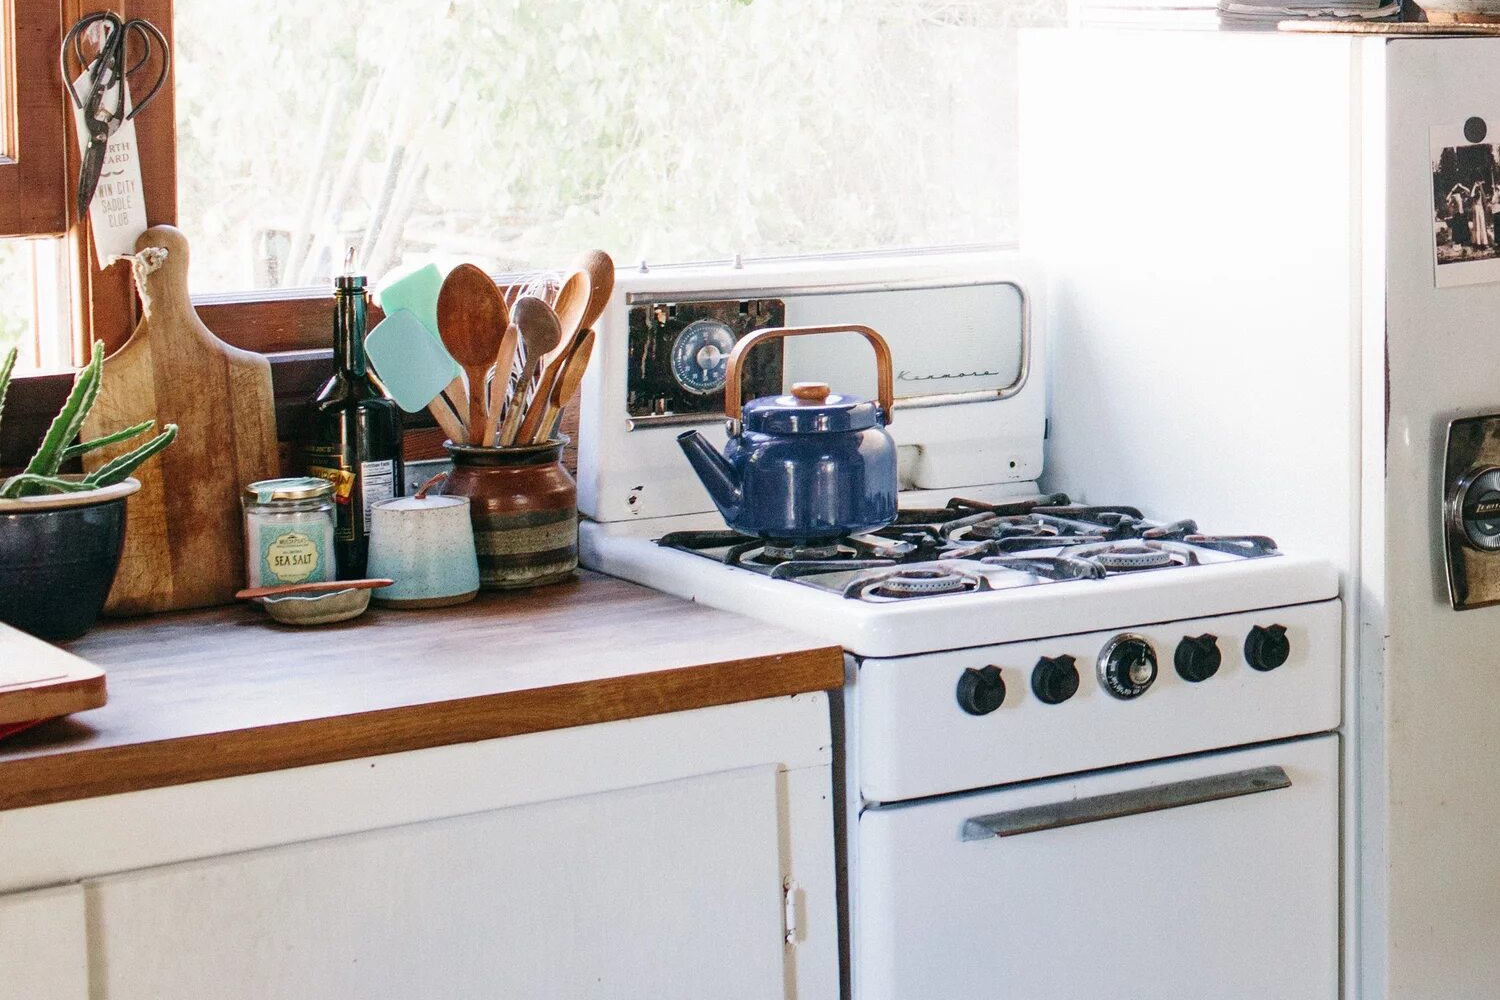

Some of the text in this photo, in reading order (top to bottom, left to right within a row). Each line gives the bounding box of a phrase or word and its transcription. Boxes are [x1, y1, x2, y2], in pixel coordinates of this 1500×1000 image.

[95, 180, 135, 198] WIN CITY
[101, 195, 132, 213] SADDLE
[108, 211, 129, 228] CLUB
[897, 370, 999, 381] Kenmore
[274, 553, 313, 567] SEA SALT
